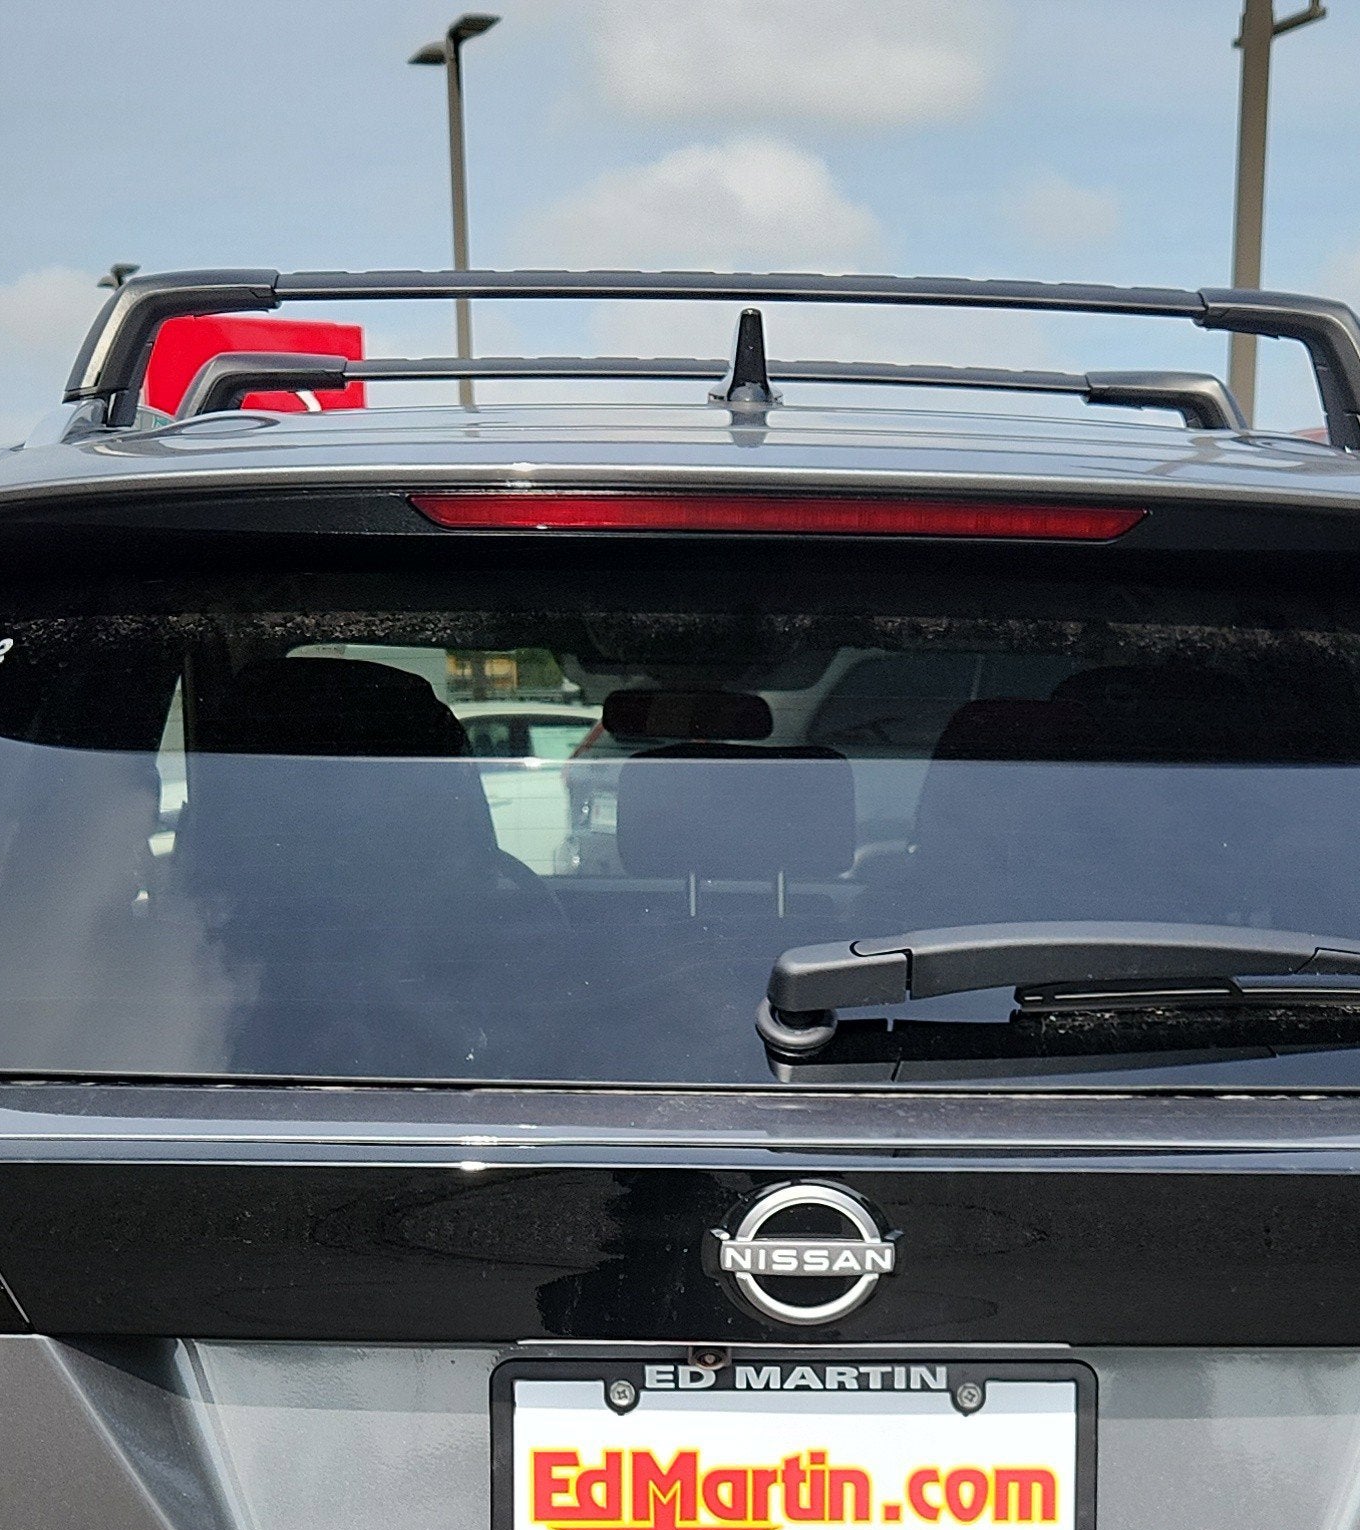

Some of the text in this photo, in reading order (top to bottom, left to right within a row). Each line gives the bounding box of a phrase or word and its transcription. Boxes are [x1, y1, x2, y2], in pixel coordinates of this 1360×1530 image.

[723, 1245, 895, 1274] NISSAN
[645, 1364, 948, 1390] ED MARTIN
